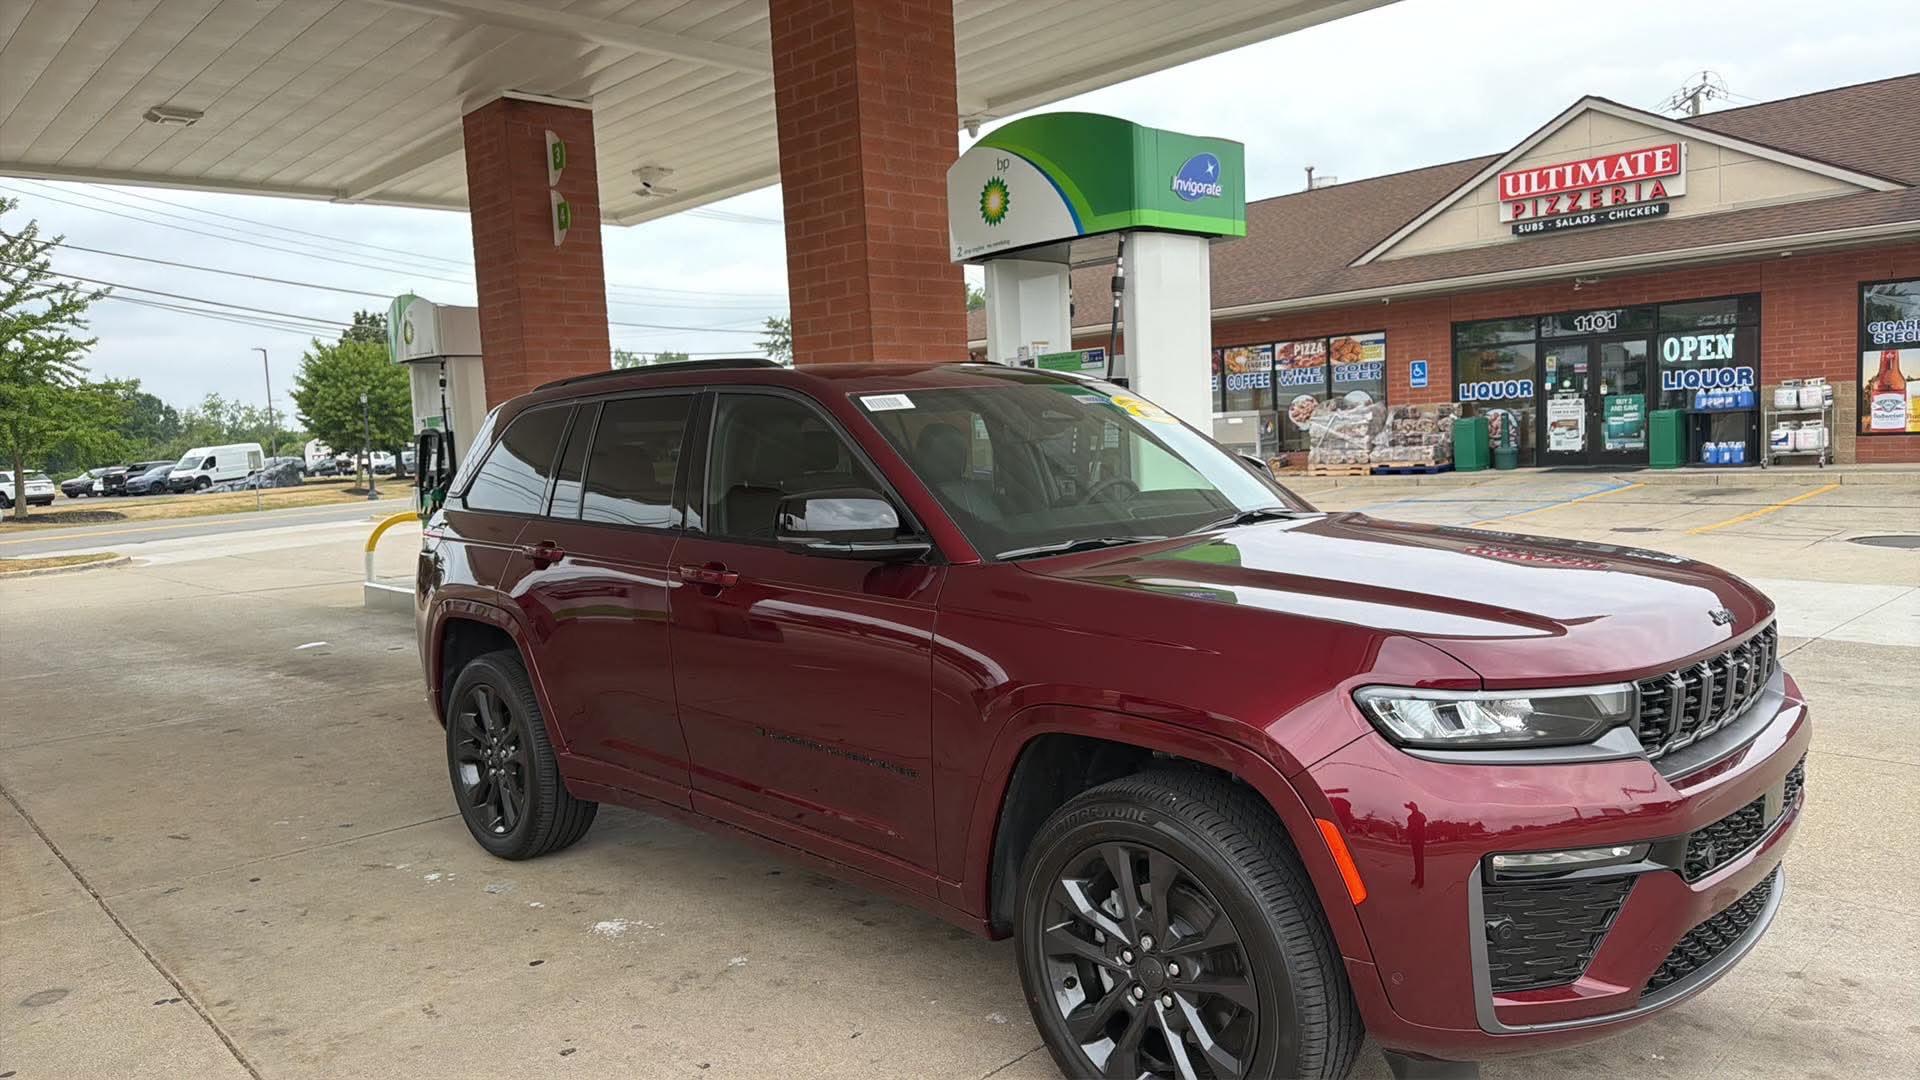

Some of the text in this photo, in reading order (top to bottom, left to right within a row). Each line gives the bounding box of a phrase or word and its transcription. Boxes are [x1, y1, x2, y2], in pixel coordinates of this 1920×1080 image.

[997, 156, 1010, 173] bp
[1503, 147, 1673, 196] ULTIMATE
[1173, 176, 1221, 197] Invigorate
[1511, 180, 1668, 219] PIZZERIA
[1518, 205, 1660, 233] SUBS SALADS CHICKEN
[1574, 312, 1617, 331] 1101
[1294, 342, 1323, 356] PIZZA
[1663, 333, 1734, 362] OPEN
[1281, 367, 1321, 377] FINE
[1333, 361, 1382, 373] COLD
[1334, 370, 1382, 383] BEER
[1227, 372, 1270, 391] COFFEE
[1280, 375, 1324, 387] WINE
[1662, 366, 1755, 391] LIQUOR
[1459, 379, 1534, 401] LIQUOR
